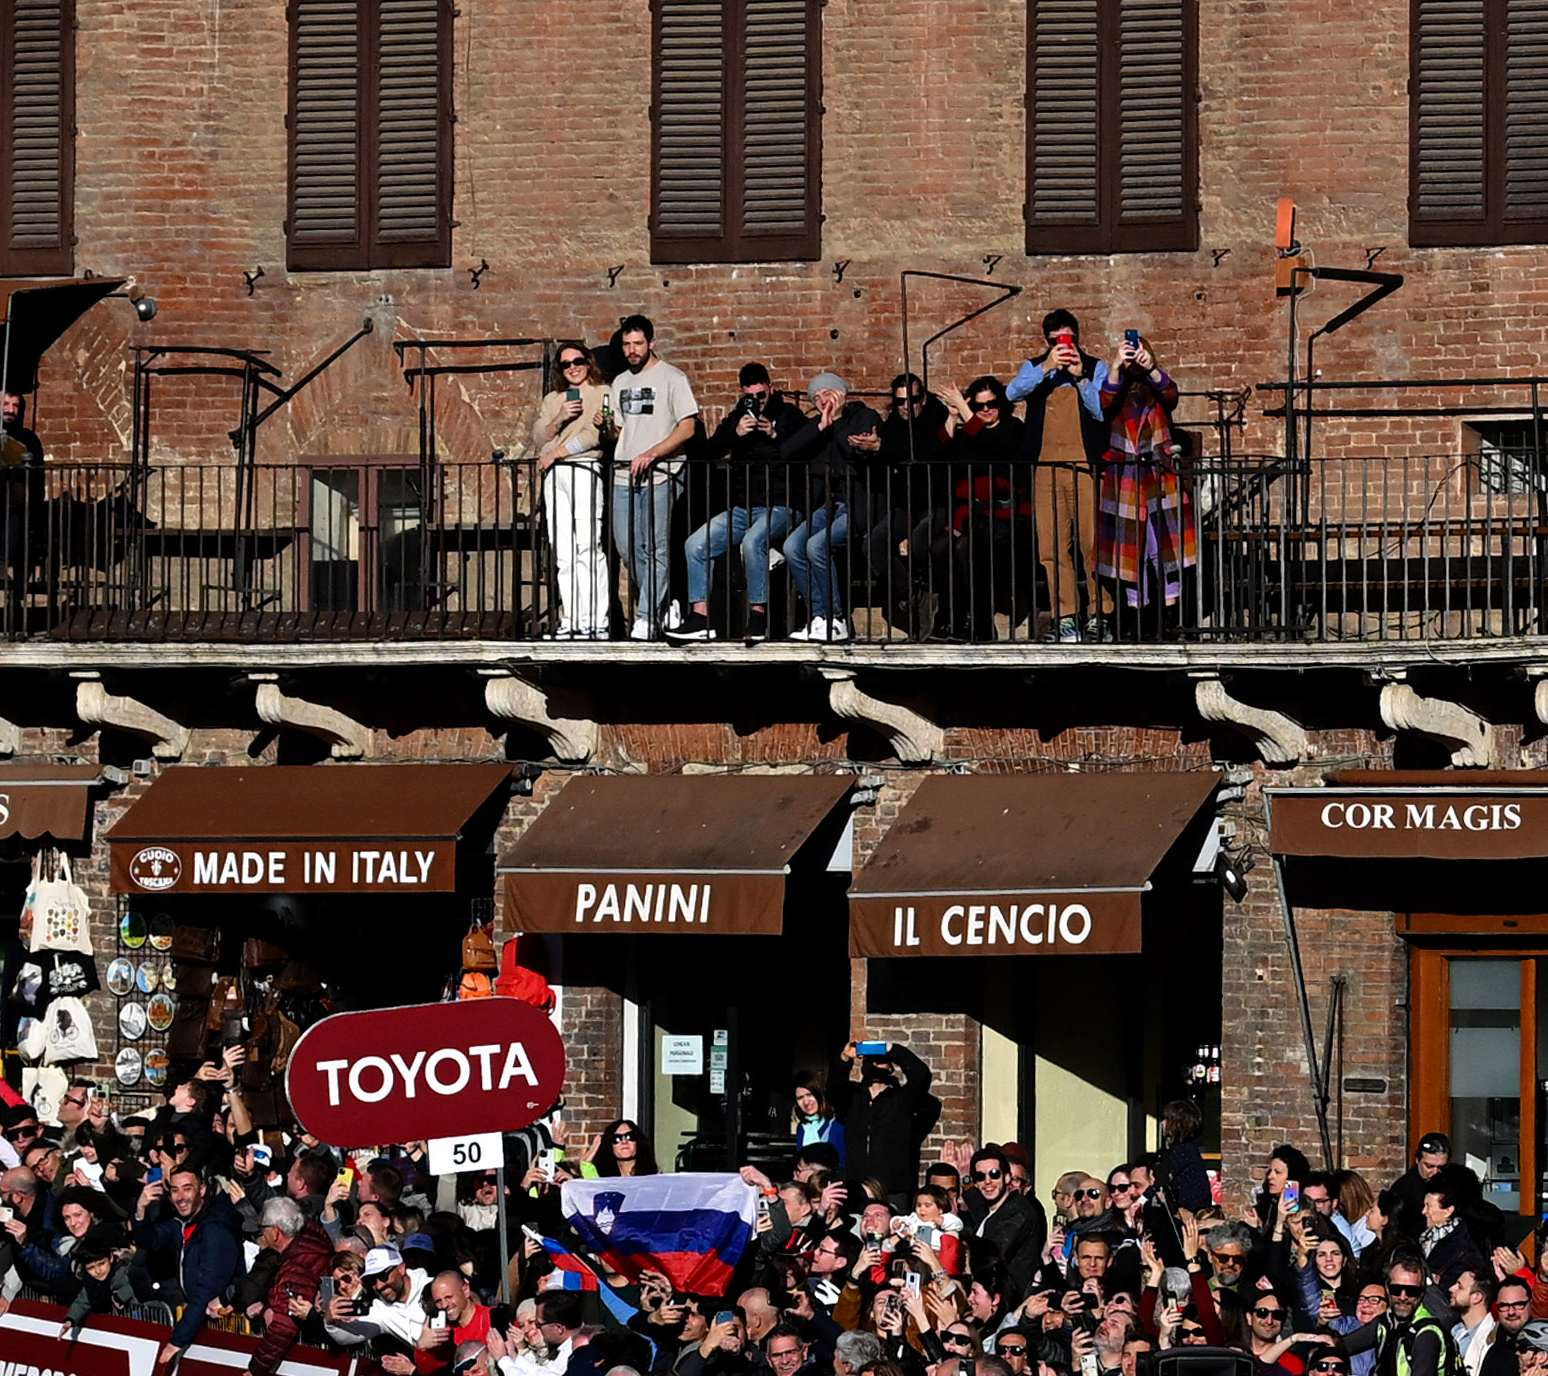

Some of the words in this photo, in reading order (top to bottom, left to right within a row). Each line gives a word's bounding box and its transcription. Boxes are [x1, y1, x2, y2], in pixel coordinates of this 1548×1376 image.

[1320, 803, 1394, 830] COR
[1405, 803, 1522, 831] MAGIS
[139, 850, 174, 864] CUOIO
[193, 852, 286, 884] MADE
[303, 852, 336, 884] IN
[352, 851, 435, 884] ITALY
[575, 883, 711, 924] PANINI
[893, 907, 920, 947] IL
[940, 904, 1092, 946] CENCIO
[316, 1041, 539, 1106] TOYOTA
[452, 1141, 483, 1166] 50
